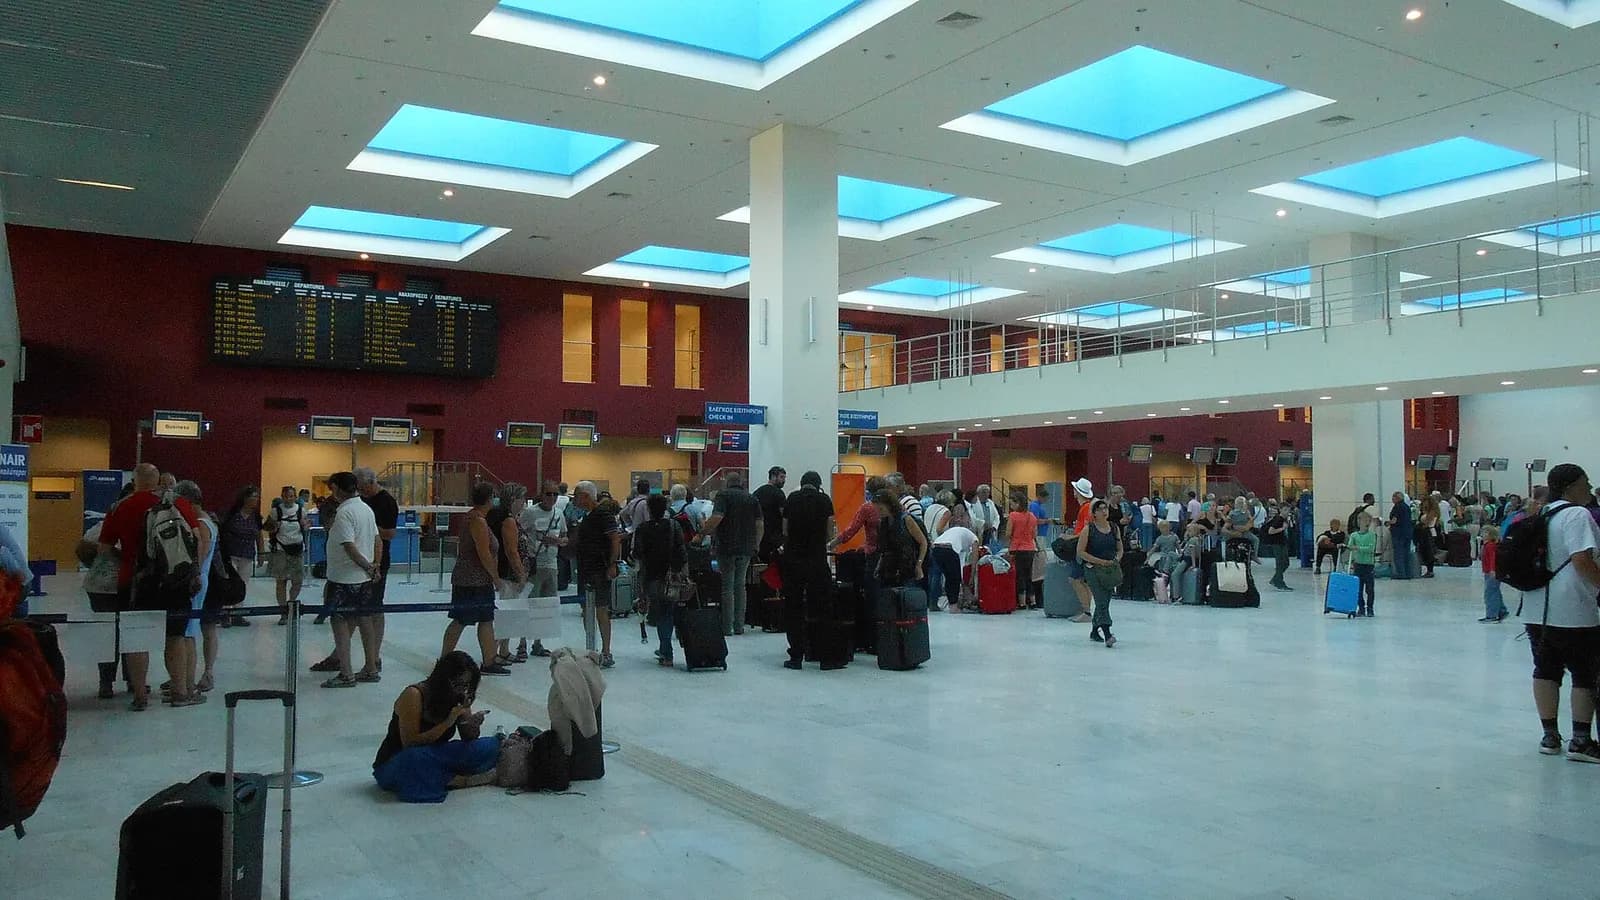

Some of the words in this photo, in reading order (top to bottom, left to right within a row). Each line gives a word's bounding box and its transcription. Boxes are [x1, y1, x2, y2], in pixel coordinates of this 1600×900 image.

[205, 422, 210, 431] 1
[300, 425, 307, 434] 2
[412, 428, 418, 437] 3
[497, 430, 503, 439] 4
[593, 433, 599, 442] 5
